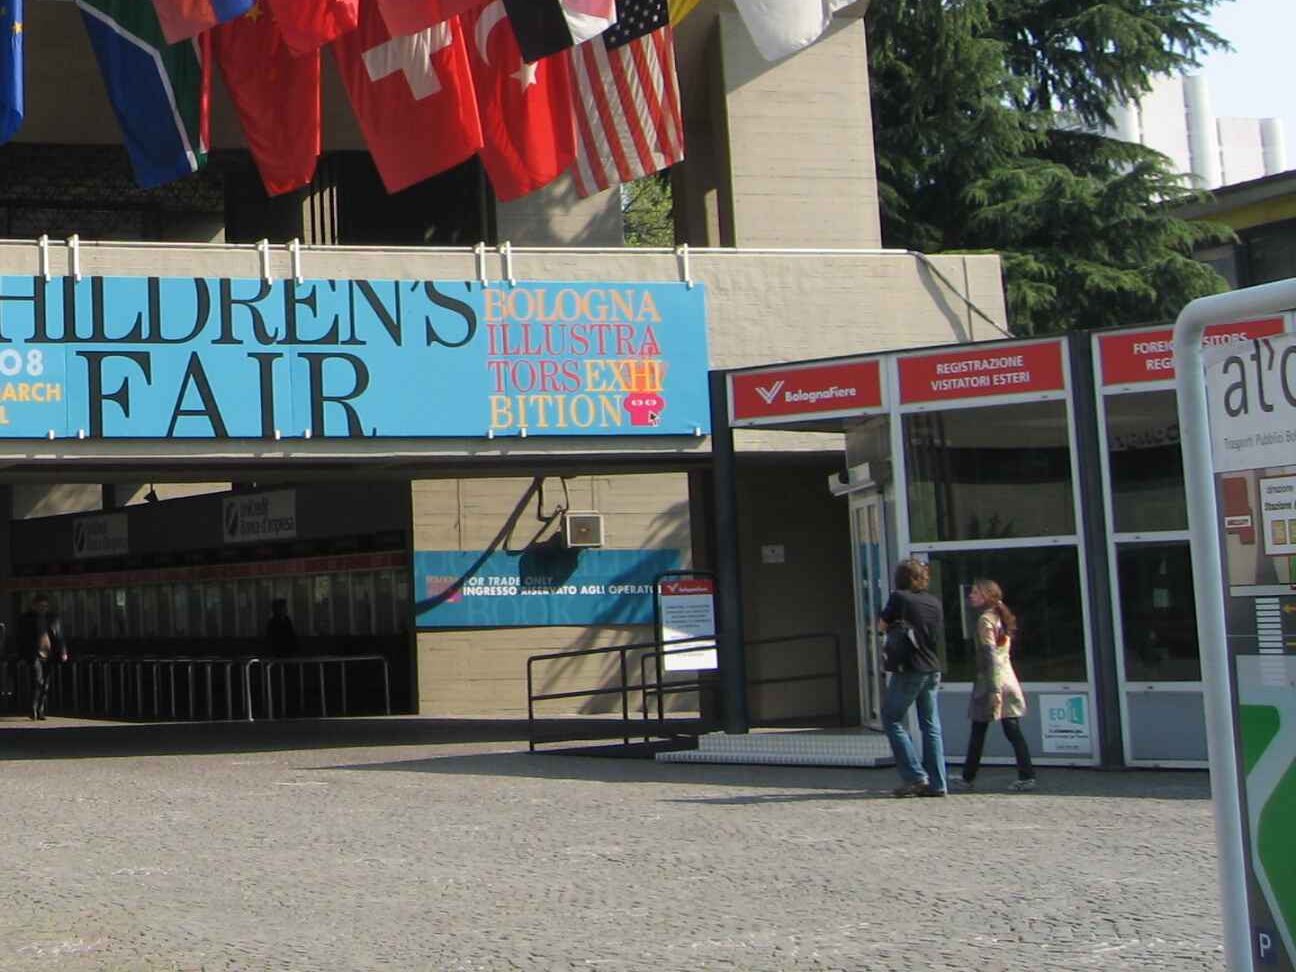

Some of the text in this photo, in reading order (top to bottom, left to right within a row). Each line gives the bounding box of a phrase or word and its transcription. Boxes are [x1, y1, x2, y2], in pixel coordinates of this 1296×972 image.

[484, 288, 662, 324] BOLOGNA
[486, 324, 662, 357] ILLUSTRA
[487, 360, 582, 392] TORS
[936, 356, 1025, 375] REGISTRAZIONE
[75, 350, 377, 438] FAIR
[784, 385, 857, 403] BolognaFiere
[930, 371, 1032, 391] VISITATORI ESTERI
[488, 394, 623, 429] BITION
[463, 586, 518, 596] INGRESSO
[580, 585, 605, 595] AGLI
[488, 576, 520, 587] TRADE
